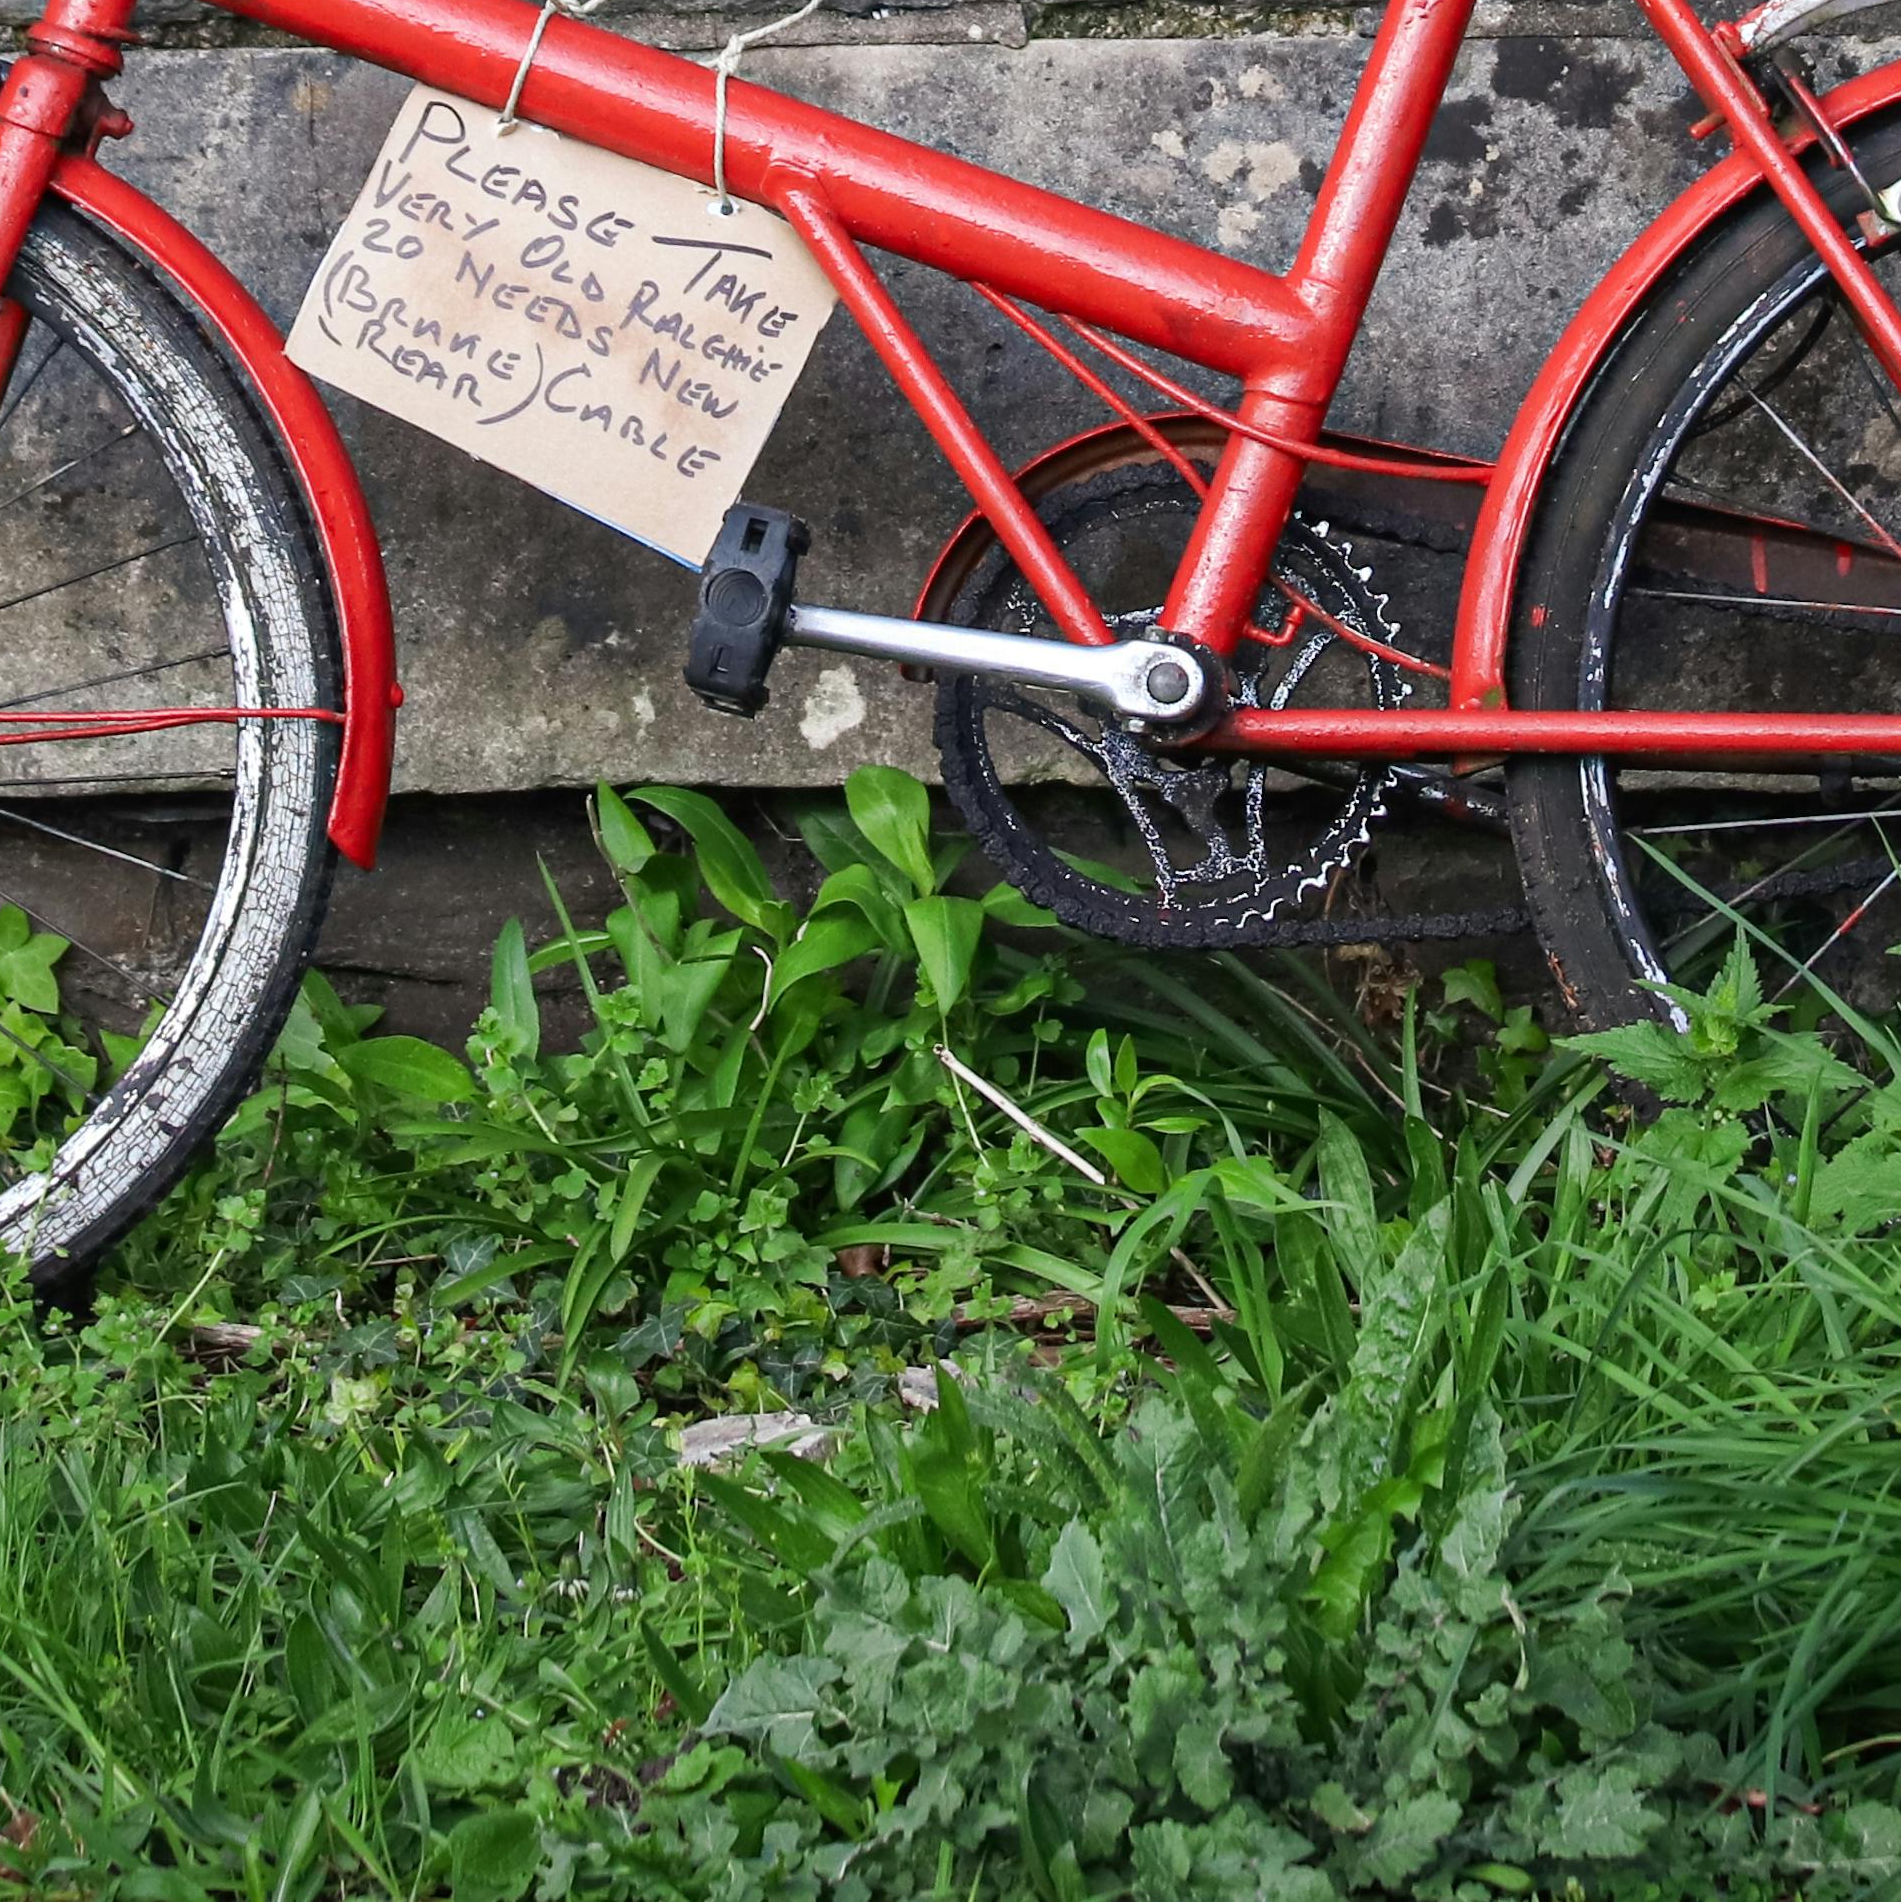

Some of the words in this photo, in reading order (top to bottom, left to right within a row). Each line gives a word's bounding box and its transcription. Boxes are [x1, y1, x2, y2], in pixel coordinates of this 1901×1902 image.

[374, 159, 500, 241] VERY
[520, 234, 604, 303] OLD
[399, 101, 636, 247] PLEASE
[651, 235, 798, 337] TAKE
[362, 218, 424, 260] 20
[456, 251, 617, 357] NEEDS
[640, 348, 739, 419] NEW
[545, 363, 721, 479] CABLE
